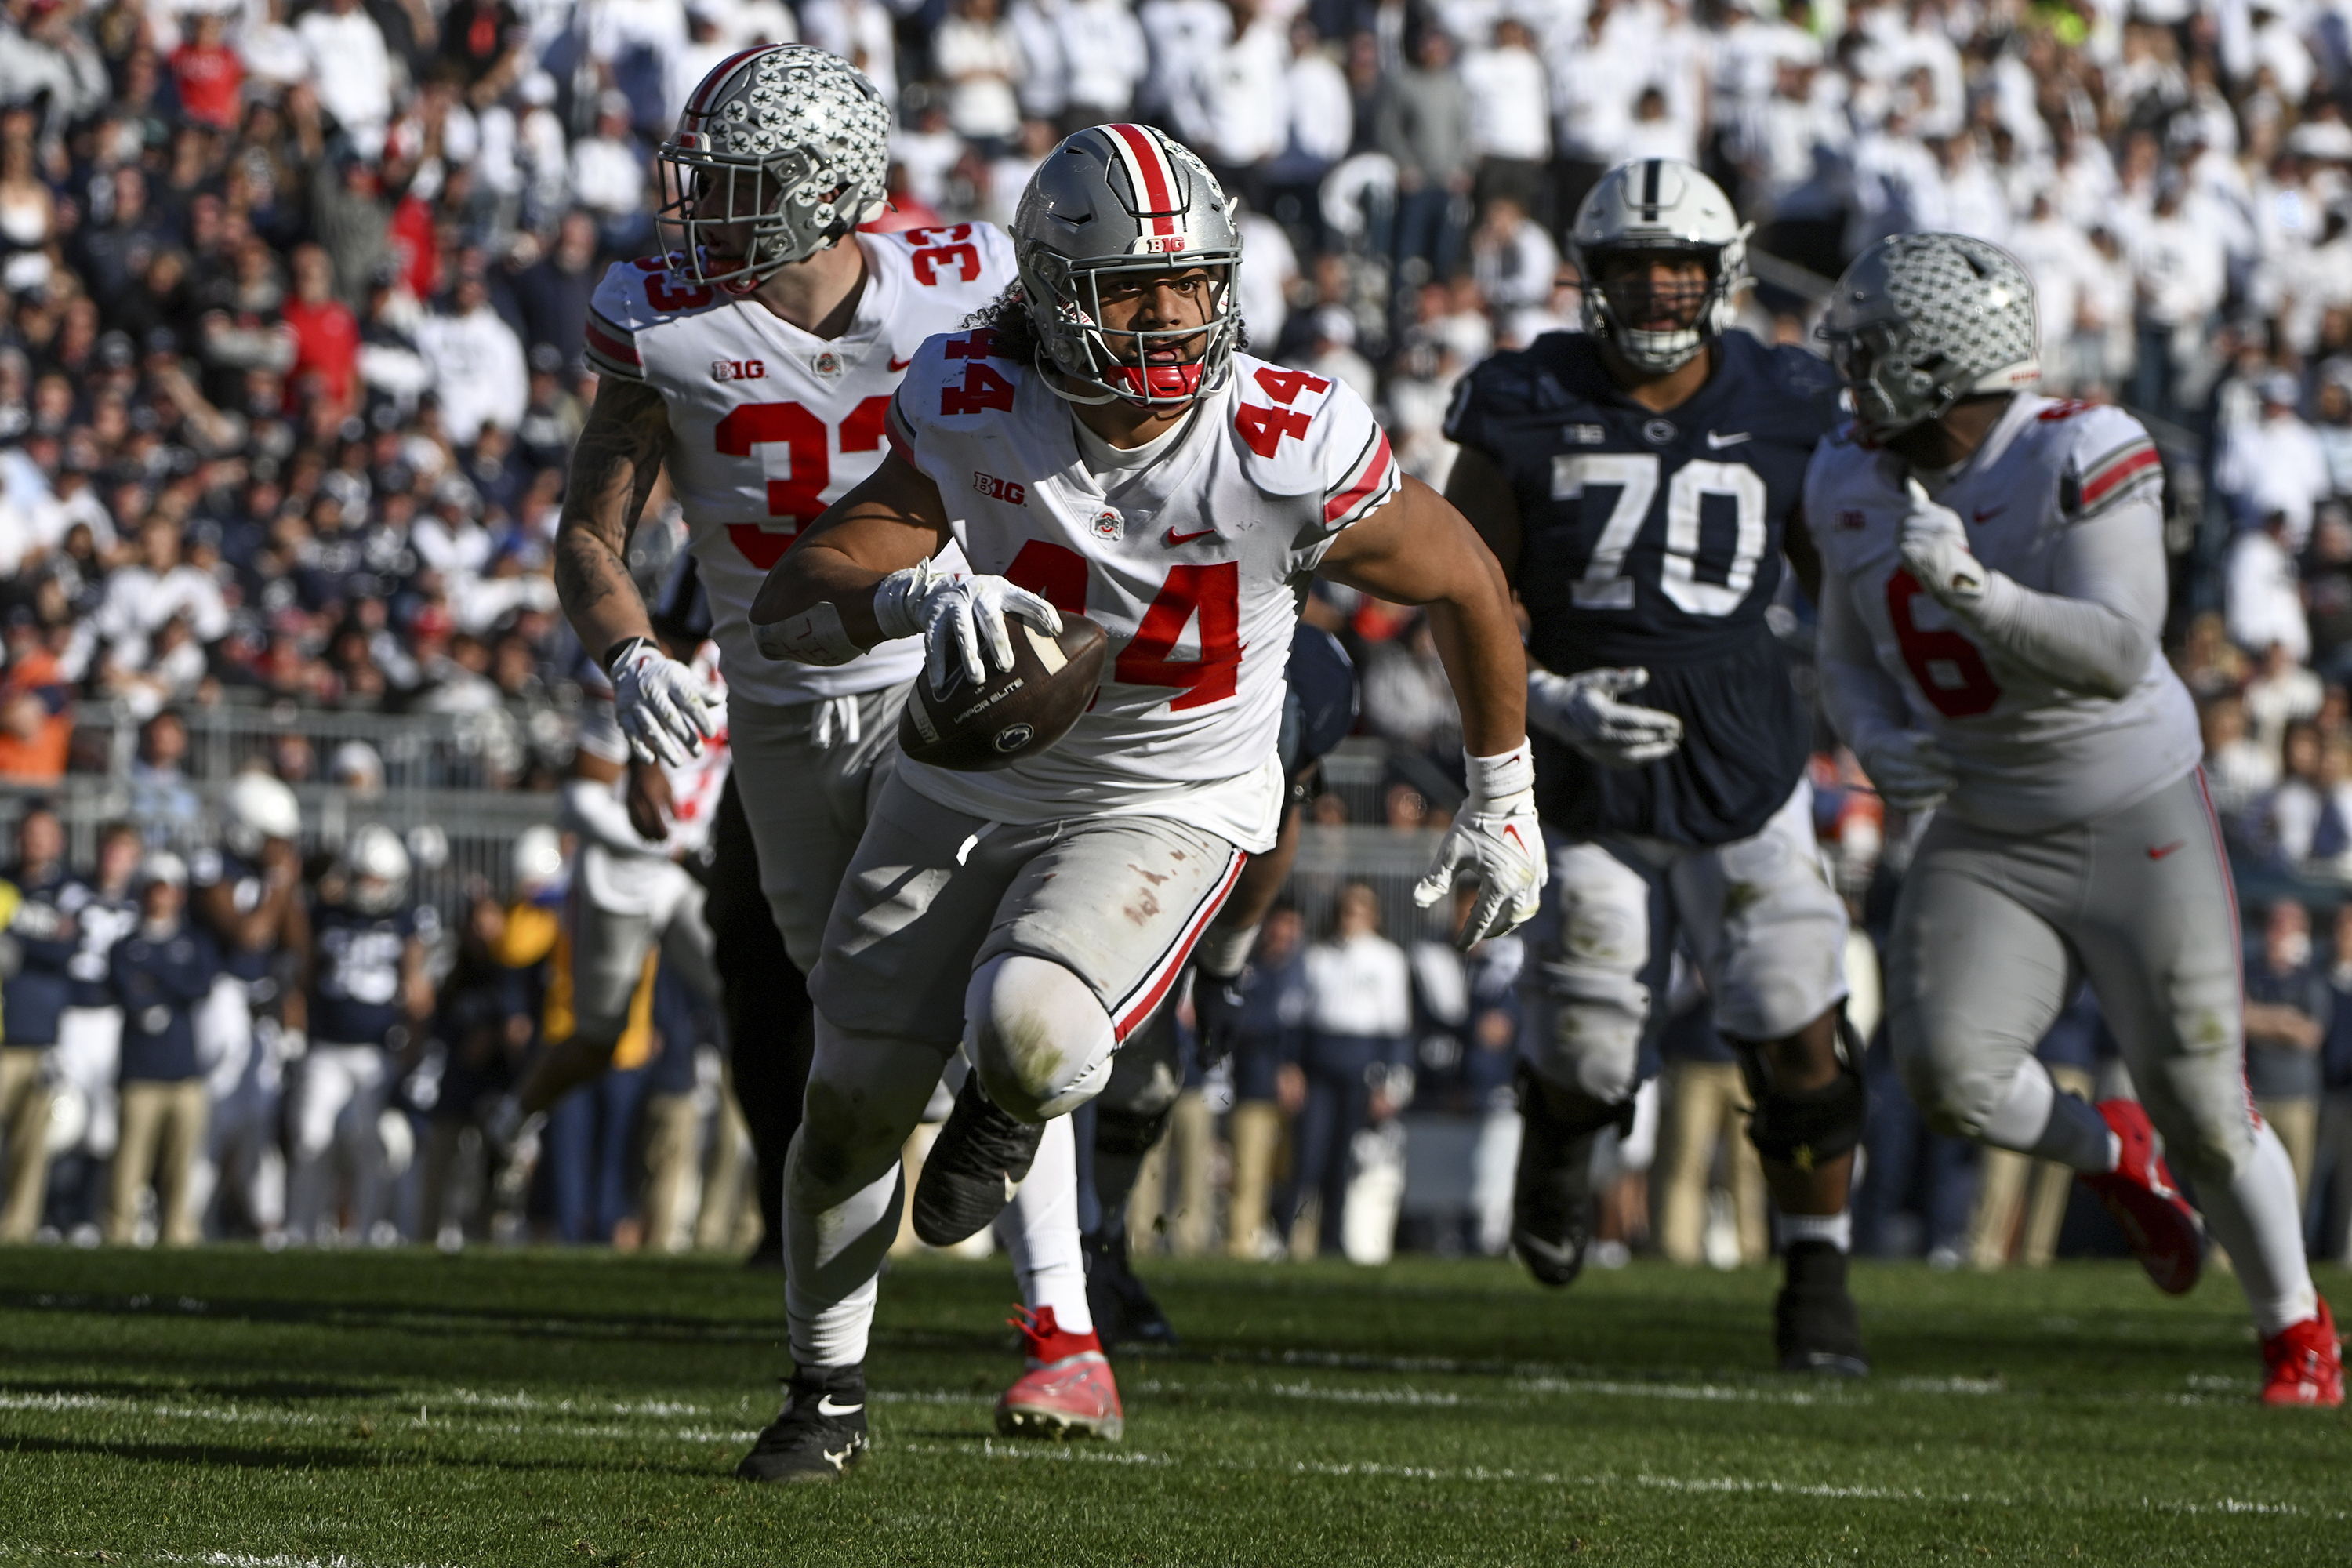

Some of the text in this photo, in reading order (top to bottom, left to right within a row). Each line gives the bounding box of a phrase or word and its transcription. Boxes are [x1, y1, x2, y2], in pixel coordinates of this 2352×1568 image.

[905, 224, 982, 286] 33
[1235, 366, 1331, 459] 44
[1550, 452, 1768, 618] 70
[1886, 566, 2002, 718] 6
[953, 699, 992, 724] VAPOR
[989, 677, 1025, 704] ELITE
